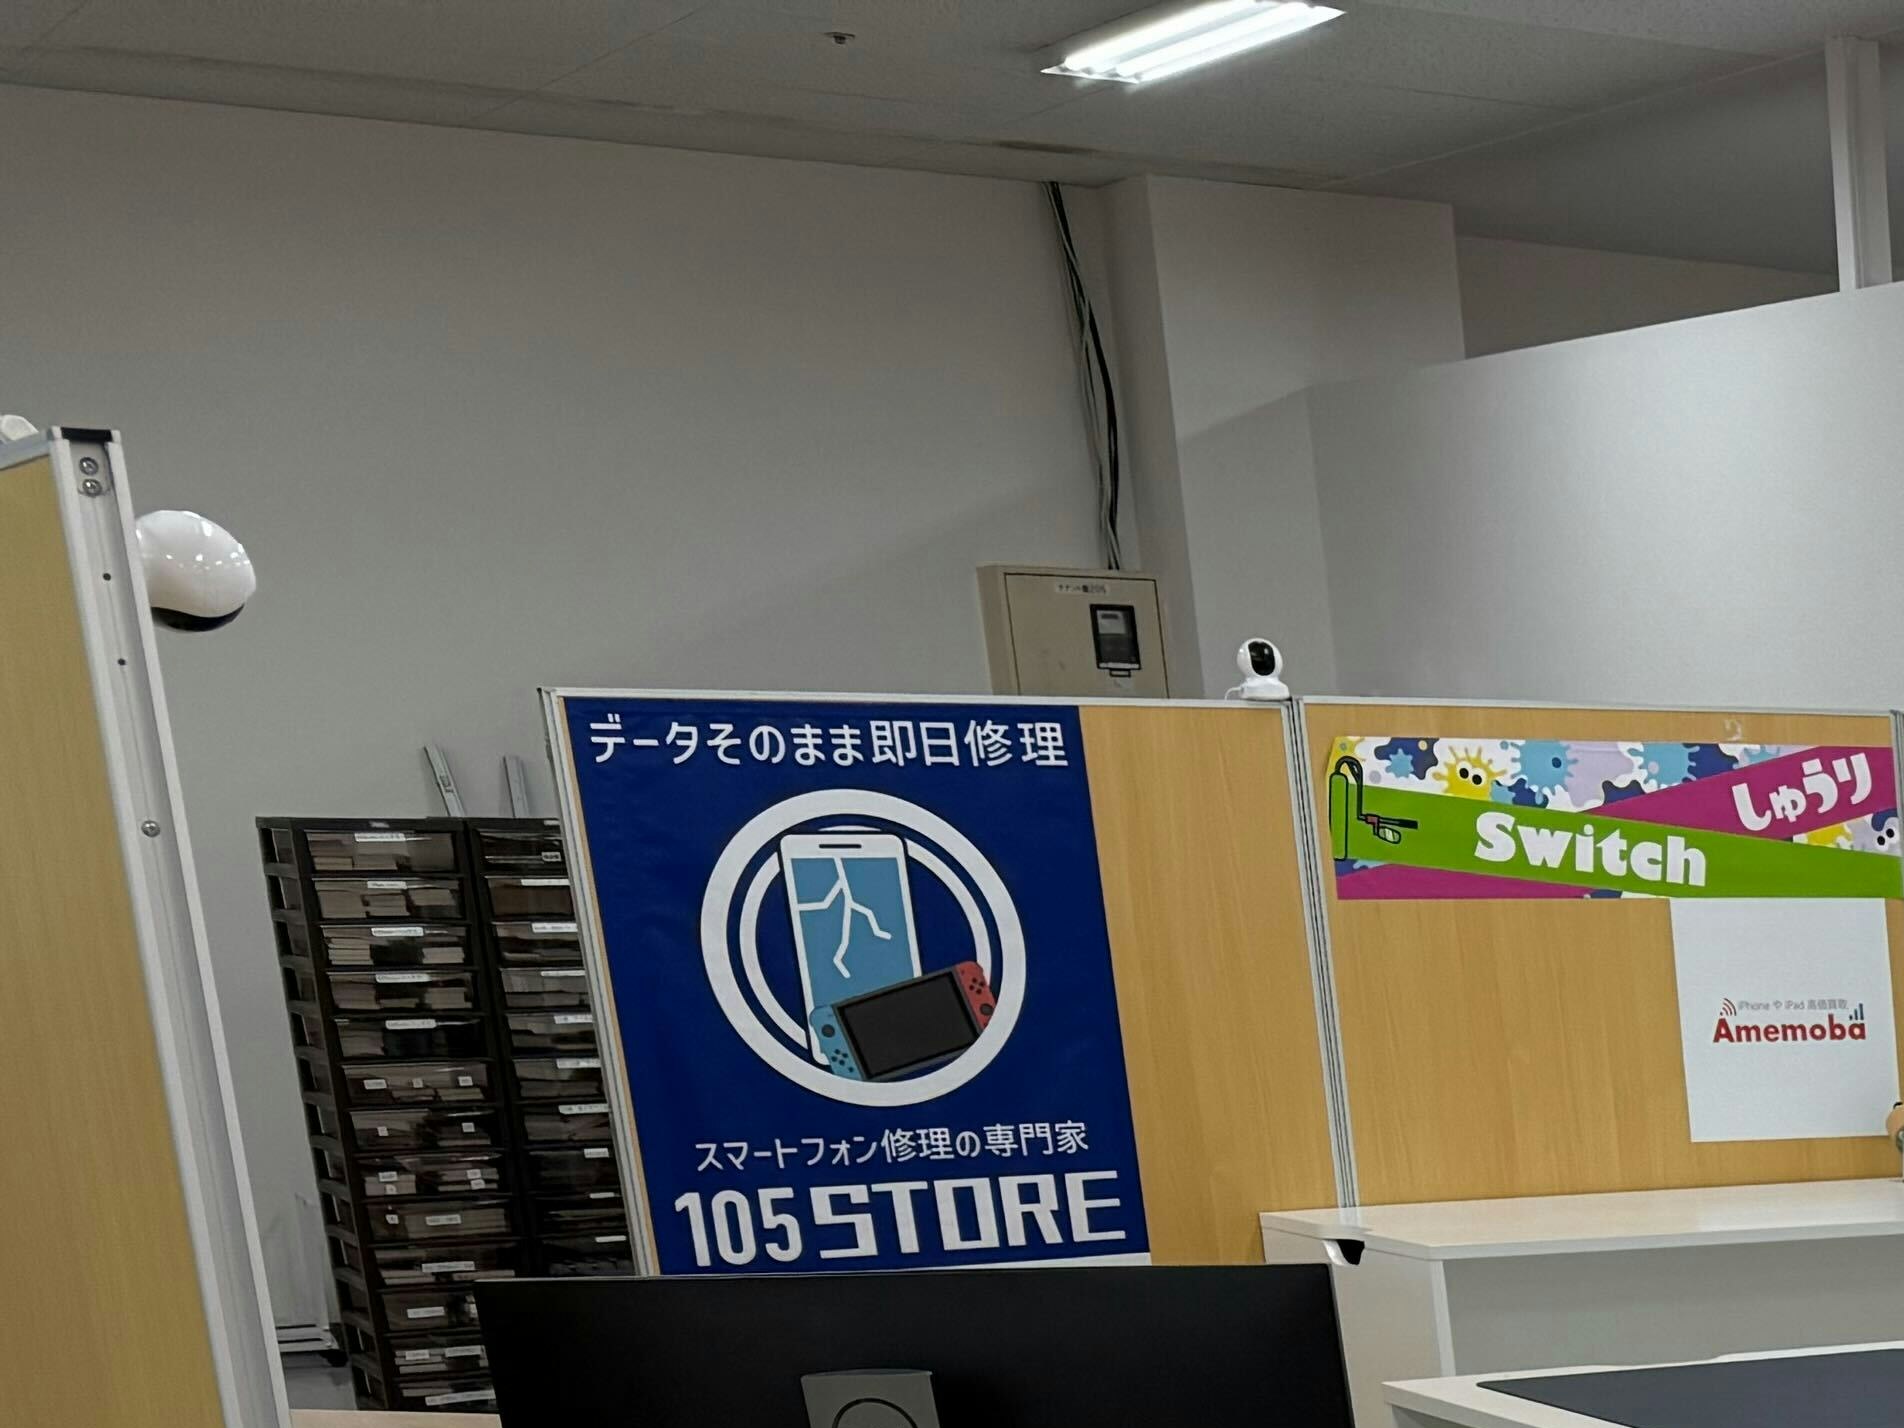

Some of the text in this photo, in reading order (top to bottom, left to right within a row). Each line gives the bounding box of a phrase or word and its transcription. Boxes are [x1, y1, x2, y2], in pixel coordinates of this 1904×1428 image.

[589, 713, 1069, 767] データそのまま即日修理
[1731, 753, 1871, 832] しゅうり
[1474, 813, 1706, 887] Switch
[1713, 1013, 1866, 1043] Amemoba
[695, 1120, 1088, 1173] スマートフォン修理の専門家
